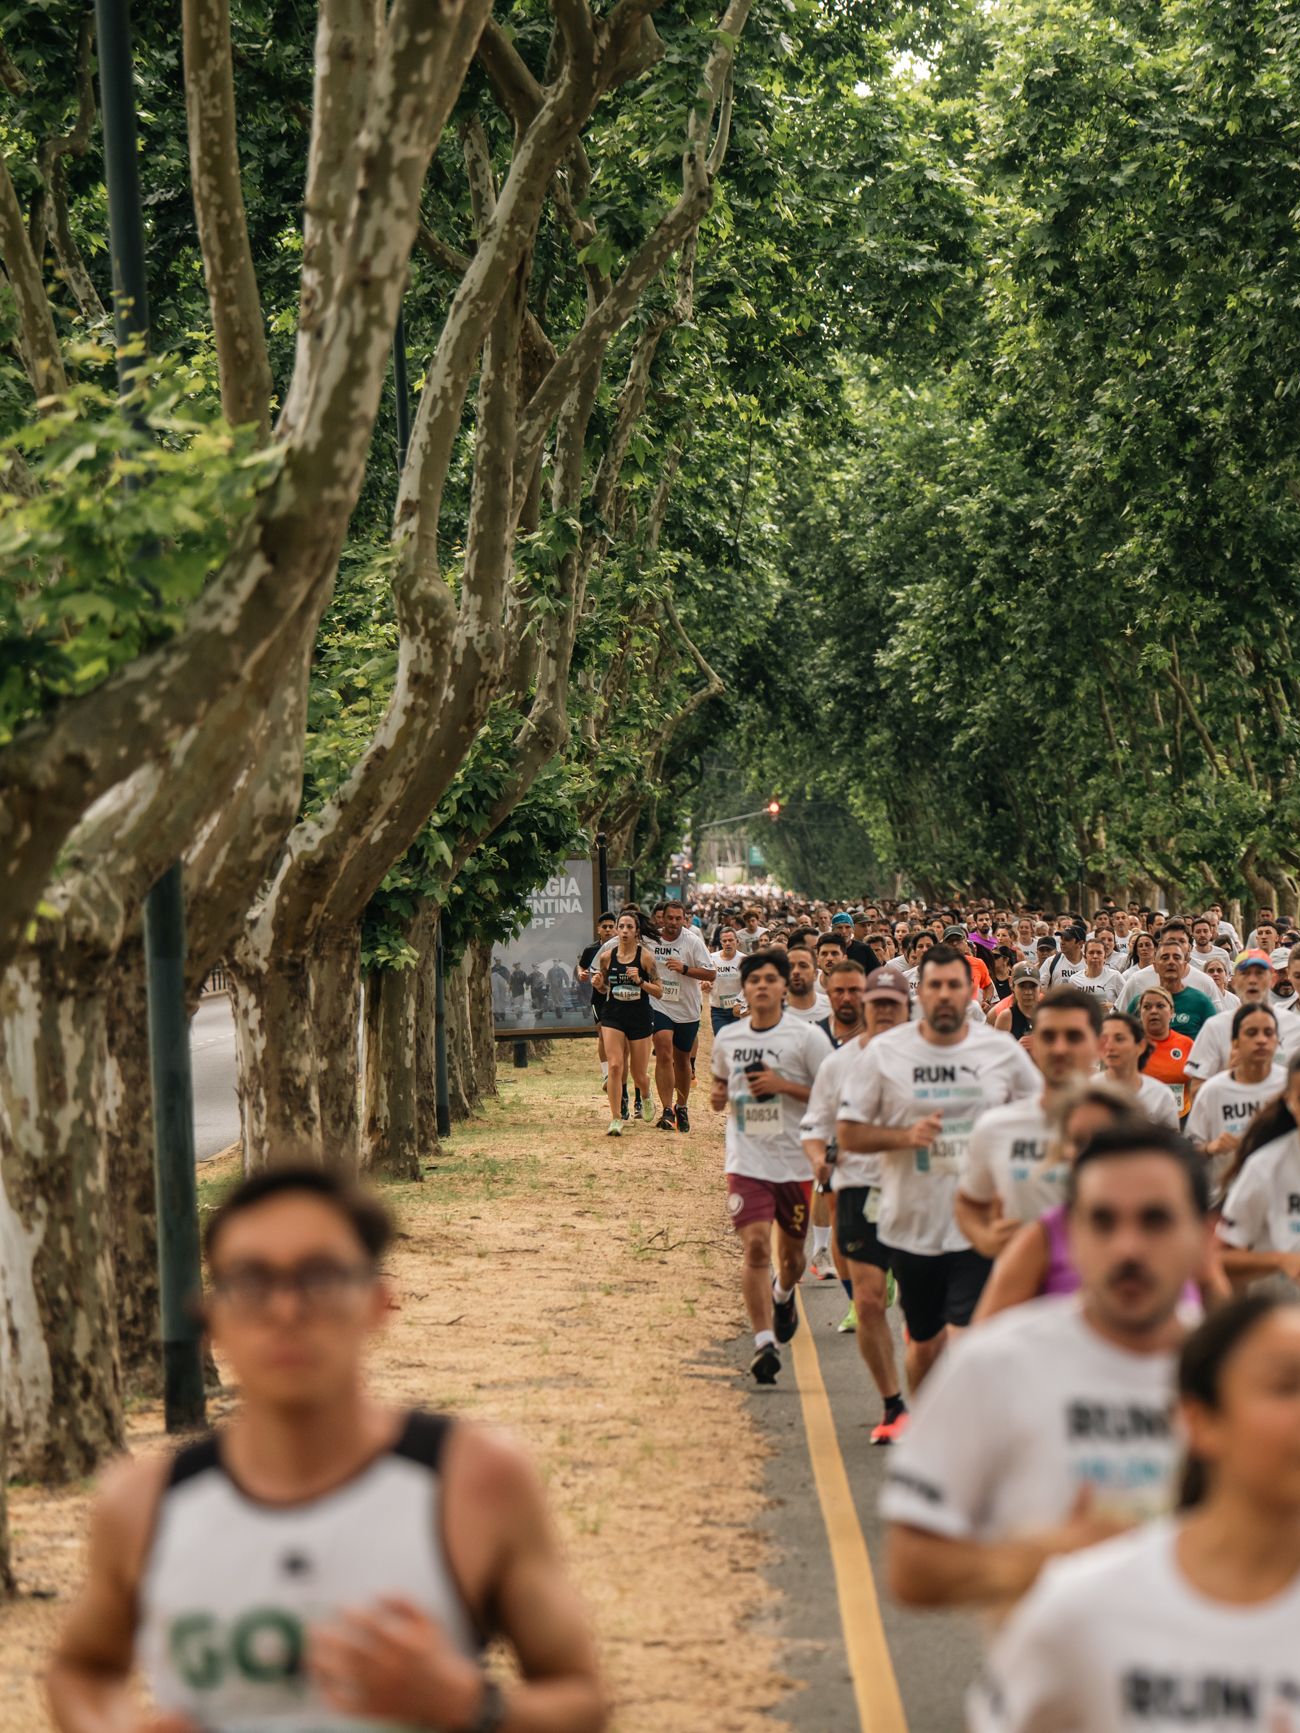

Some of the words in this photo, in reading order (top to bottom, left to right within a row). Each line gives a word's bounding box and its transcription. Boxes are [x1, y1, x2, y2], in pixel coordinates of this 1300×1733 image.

[655, 947, 672, 955] RUN
[733, 1049, 764, 1062] RUN
[913, 1066, 956, 1083] RUN
